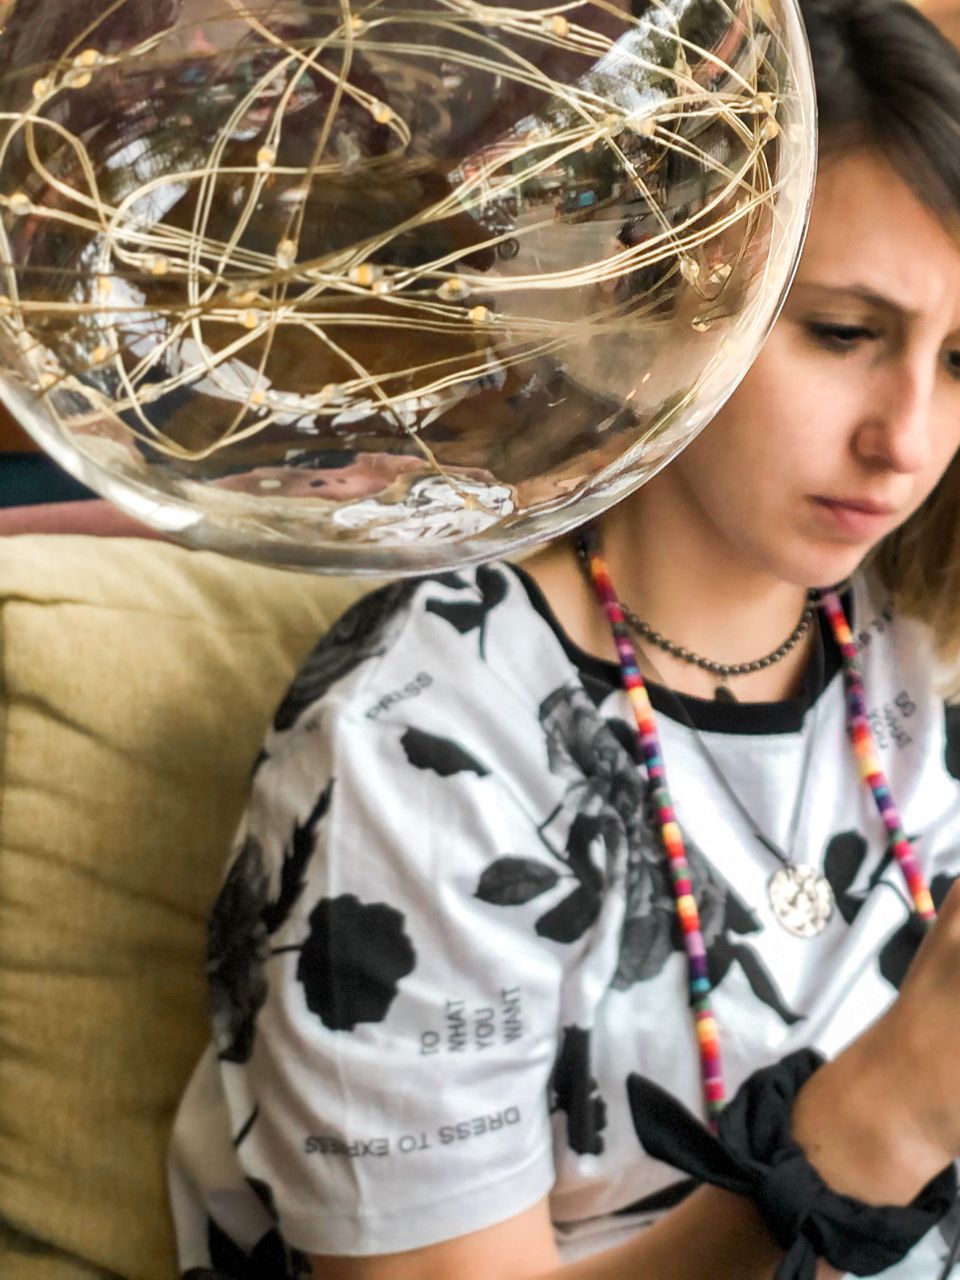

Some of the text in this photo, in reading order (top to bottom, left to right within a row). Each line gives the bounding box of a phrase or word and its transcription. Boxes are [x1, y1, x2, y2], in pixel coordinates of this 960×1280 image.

[474, 1007, 495, 1051] YOU
[501, 986, 523, 1046] WANT
[397, 1132, 431, 1155] TO
[438, 1106, 522, 1146] DRESS
